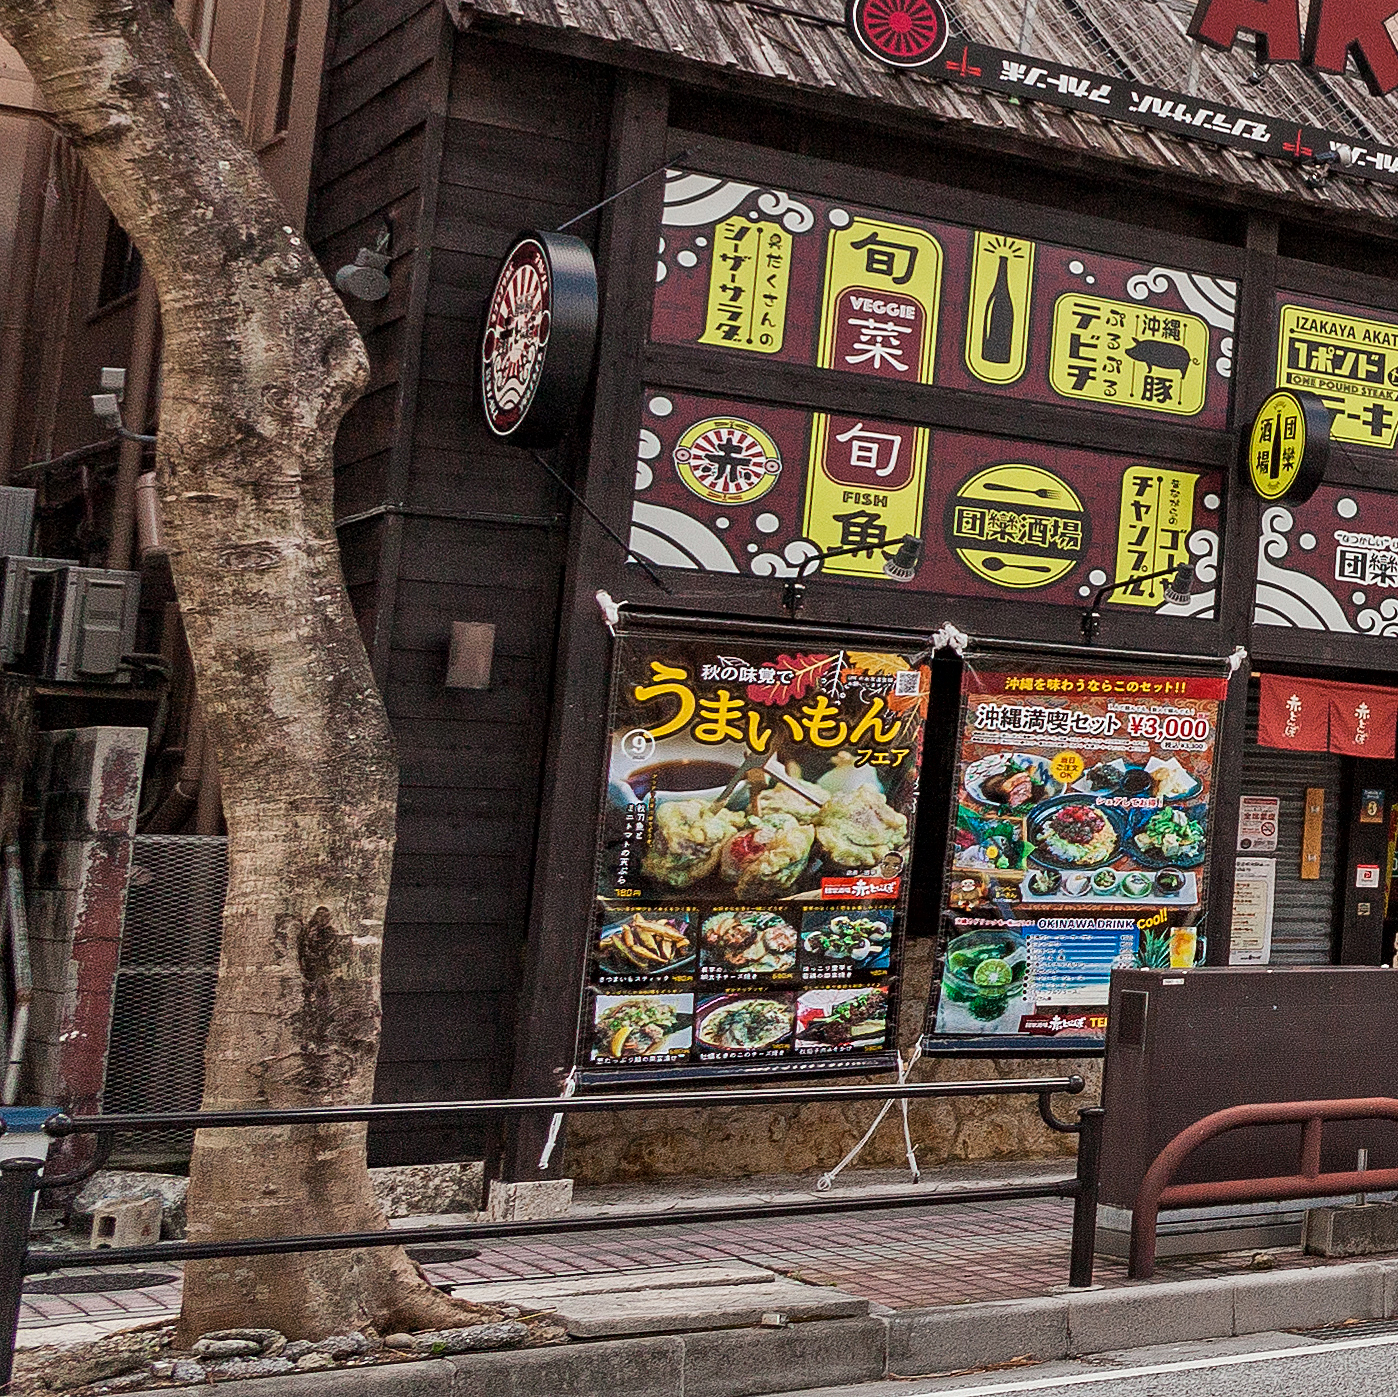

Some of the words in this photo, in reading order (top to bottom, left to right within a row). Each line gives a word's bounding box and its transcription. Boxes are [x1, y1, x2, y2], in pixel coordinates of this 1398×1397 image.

[1000, 57, 1111, 104] アカトンボ
[850, 231, 919, 286] 旬
[714, 221, 751, 343] シーザーサラダ
[849, 295, 917, 321] VEGGIE
[1140, 313, 1182, 341] 沖縄
[1295, 315, 1358, 341] IZAKAYA
[845, 317, 912, 372] 菜
[1066, 302, 1103, 392] テビチ
[1140, 374, 1174, 404] 豚
[1292, 374, 1316, 387] ONE
[1320, 378, 1358, 393] POUND
[1362, 385, 1396, 401] STEAK
[835, 422, 902, 478] 旬
[842, 490, 889, 508] FISH
[827, 509, 905, 559] 魚
[701, 663, 795, 685] 秋の味覚で
[635, 661, 901, 752] うまいもん
[976, 704, 1121, 736] 沖縄満喫セット
[1129, 714, 1210, 743] ¥3,000
[856, 748, 910, 767] フェア
[1037, 919, 1095, 930] OKINAWA
[1097, 919, 1135, 930] DRINK
